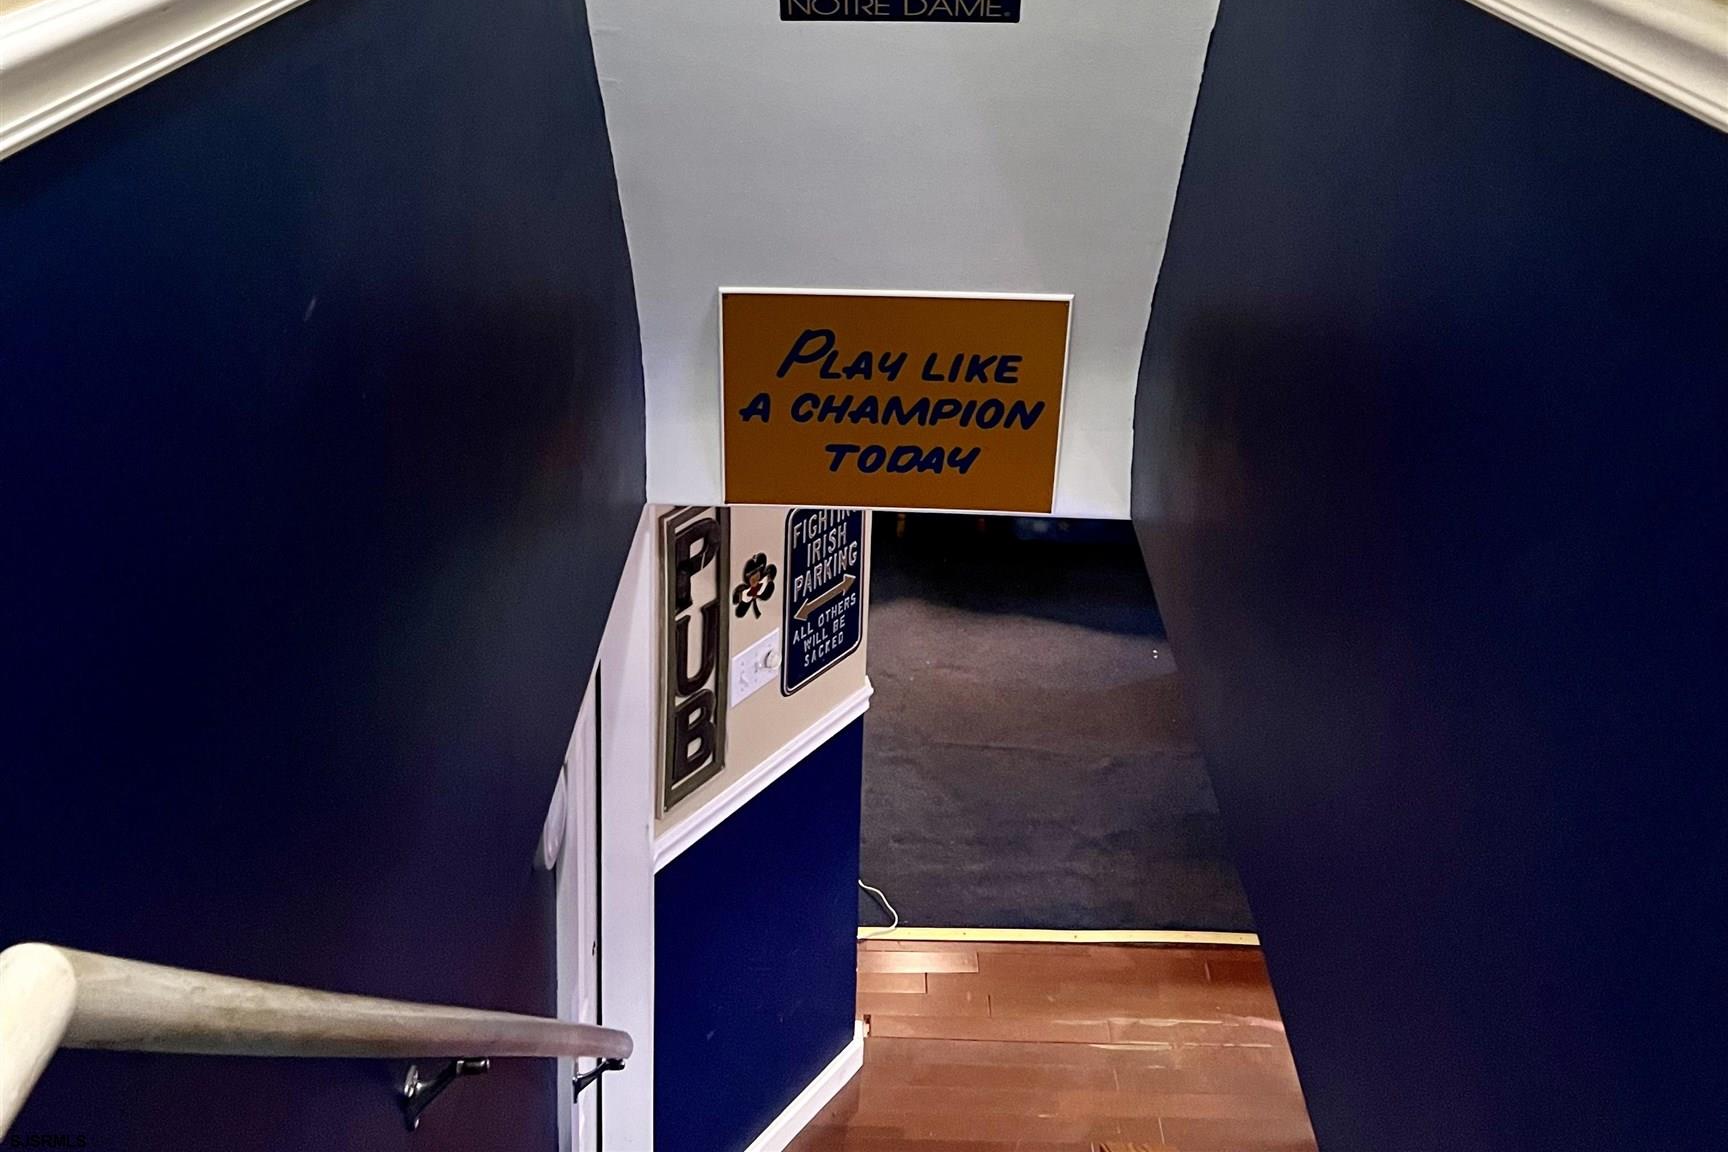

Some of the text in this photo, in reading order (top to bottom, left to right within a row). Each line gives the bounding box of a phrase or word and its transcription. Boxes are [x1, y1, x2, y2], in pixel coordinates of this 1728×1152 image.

[920, 352, 1023, 384] LIKE
[738, 392, 1046, 430] A CHAMPION
[824, 443, 982, 474] TODAY
[807, 522, 847, 567] IRISH
[794, 540, 858, 603] PARKING
[792, 592, 856, 645] ALL OTHERS
[803, 614, 846, 652] WILL BE
[674, 517, 720, 783] PUB
